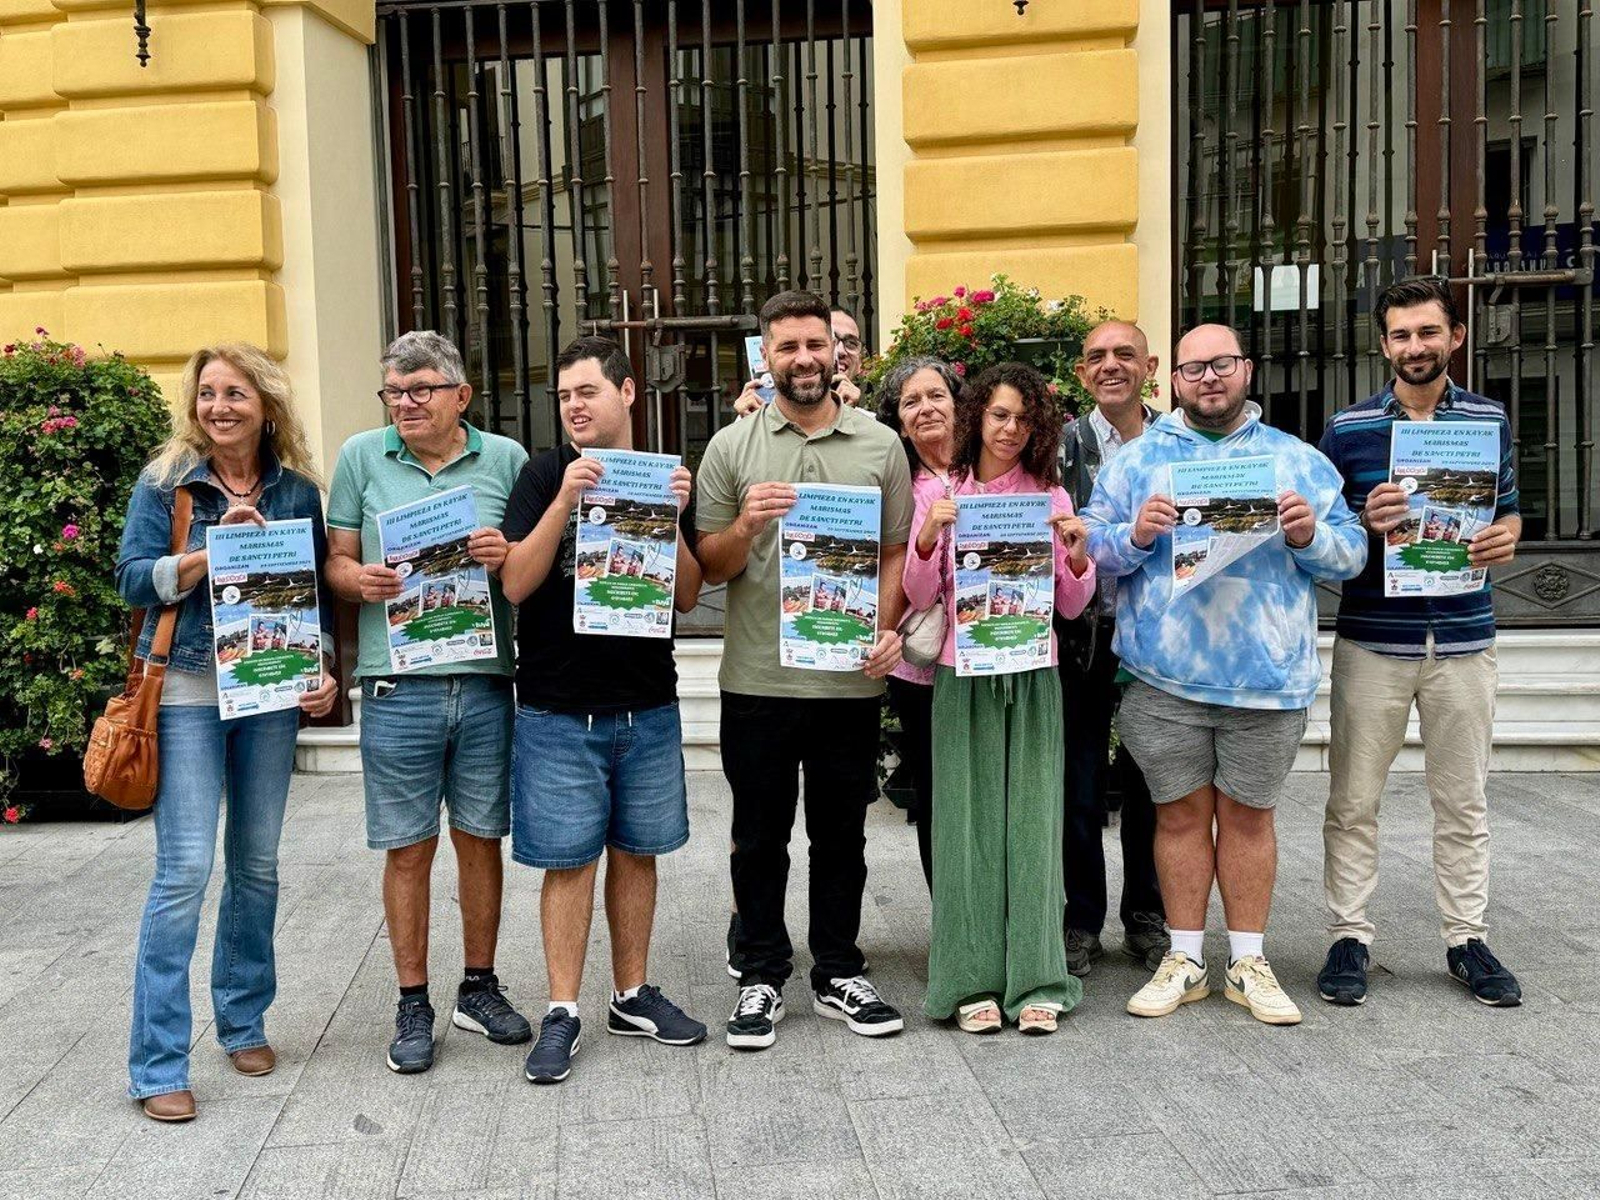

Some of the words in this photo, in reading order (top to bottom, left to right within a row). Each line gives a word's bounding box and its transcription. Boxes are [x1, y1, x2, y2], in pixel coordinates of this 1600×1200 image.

[601, 457, 636, 466] LIMPIEZA
[799, 493, 836, 501] LIMPIEZA
[810, 505, 851, 514] MARISMAS
[396, 506, 431, 522] LIMPIEZA
[226, 531, 265, 539] LIMPIEZA
[239, 541, 284, 549] MARISMAS
[241, 553, 270, 561] SANCTI
